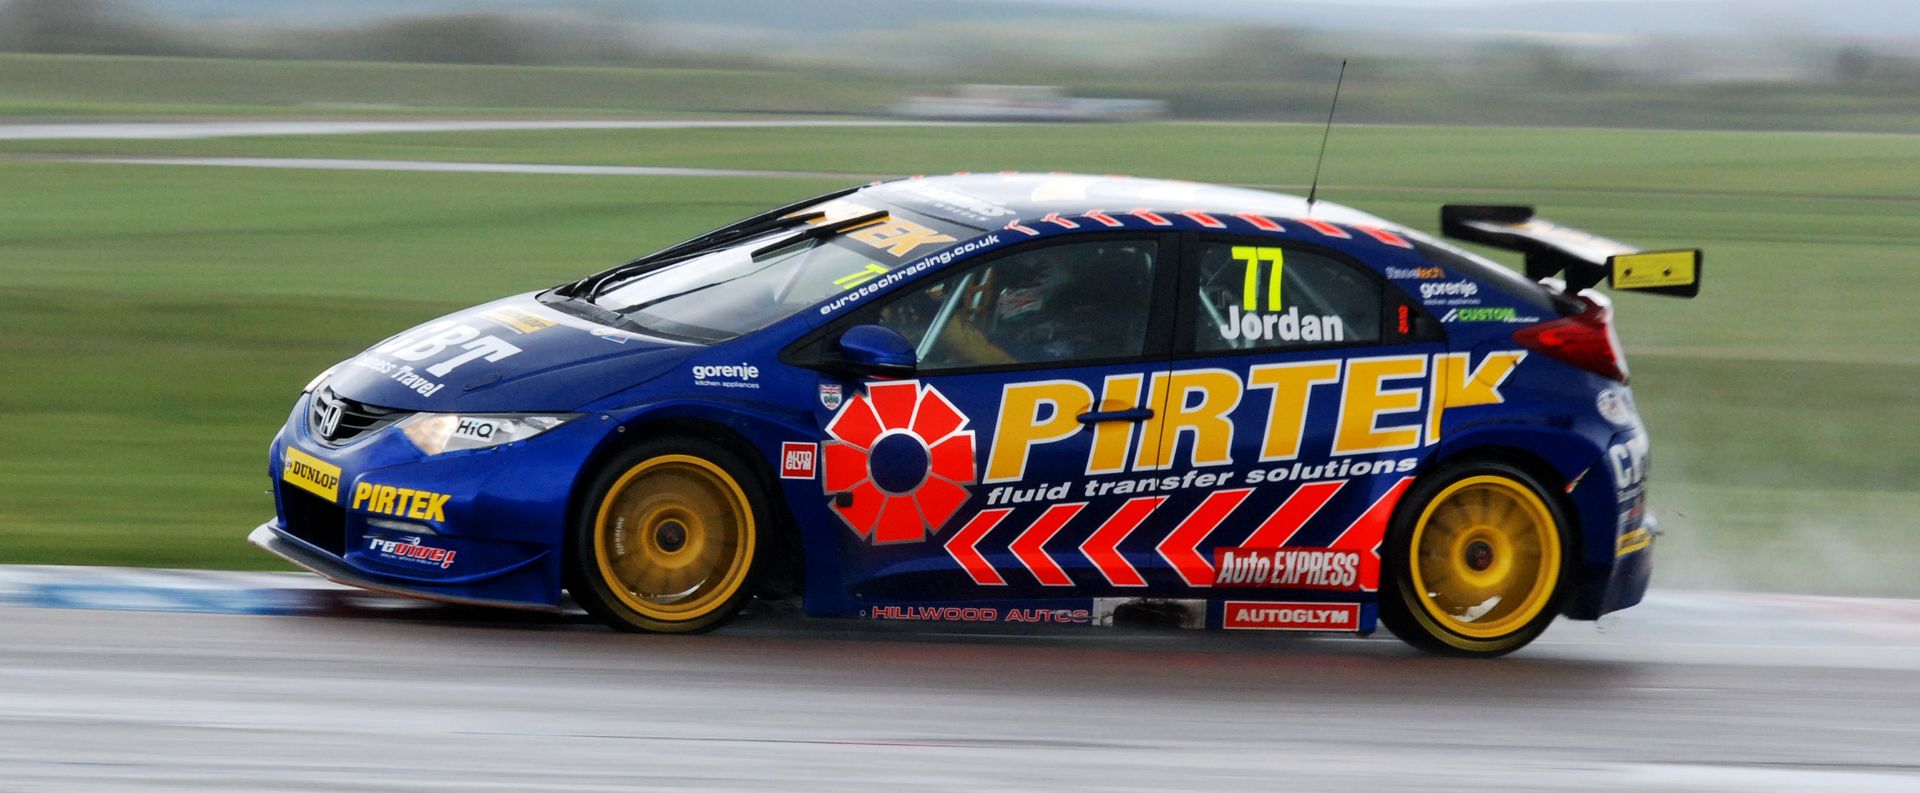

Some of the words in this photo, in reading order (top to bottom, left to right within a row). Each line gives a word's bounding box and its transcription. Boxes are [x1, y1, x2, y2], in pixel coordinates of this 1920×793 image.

[819, 233, 1000, 316] eurotechracing.co.uk
[1231, 246, 1284, 312] 77
[1420, 279, 1479, 299] gorenje
[1219, 305, 1344, 342] Jordan
[1458, 308, 1516, 322] CUSTOM
[390, 365, 445, 398] Travel
[692, 362, 759, 380] gorenje
[694, 380, 721, 388] kitchen
[722, 381, 760, 389] appliances
[455, 419, 493, 439] HiQ
[983, 350, 1527, 485] PIRTEK
[785, 460, 812, 471] GLYM
[786, 450, 812, 461] AUTO
[292, 461, 338, 491] DUNLOP
[986, 480, 1071, 506] fluid
[1084, 468, 1234, 499] transfer
[1245, 455, 1417, 484] solutions
[352, 482, 452, 523] PIRTEK
[1216, 551, 1270, 584] Auto
[1270, 551, 1360, 586] EXPRESS
[871, 606, 996, 622] HILLWOOD
[1003, 608, 1090, 624] AUTOS
[1234, 609, 1350, 623] AUTOGLYM
